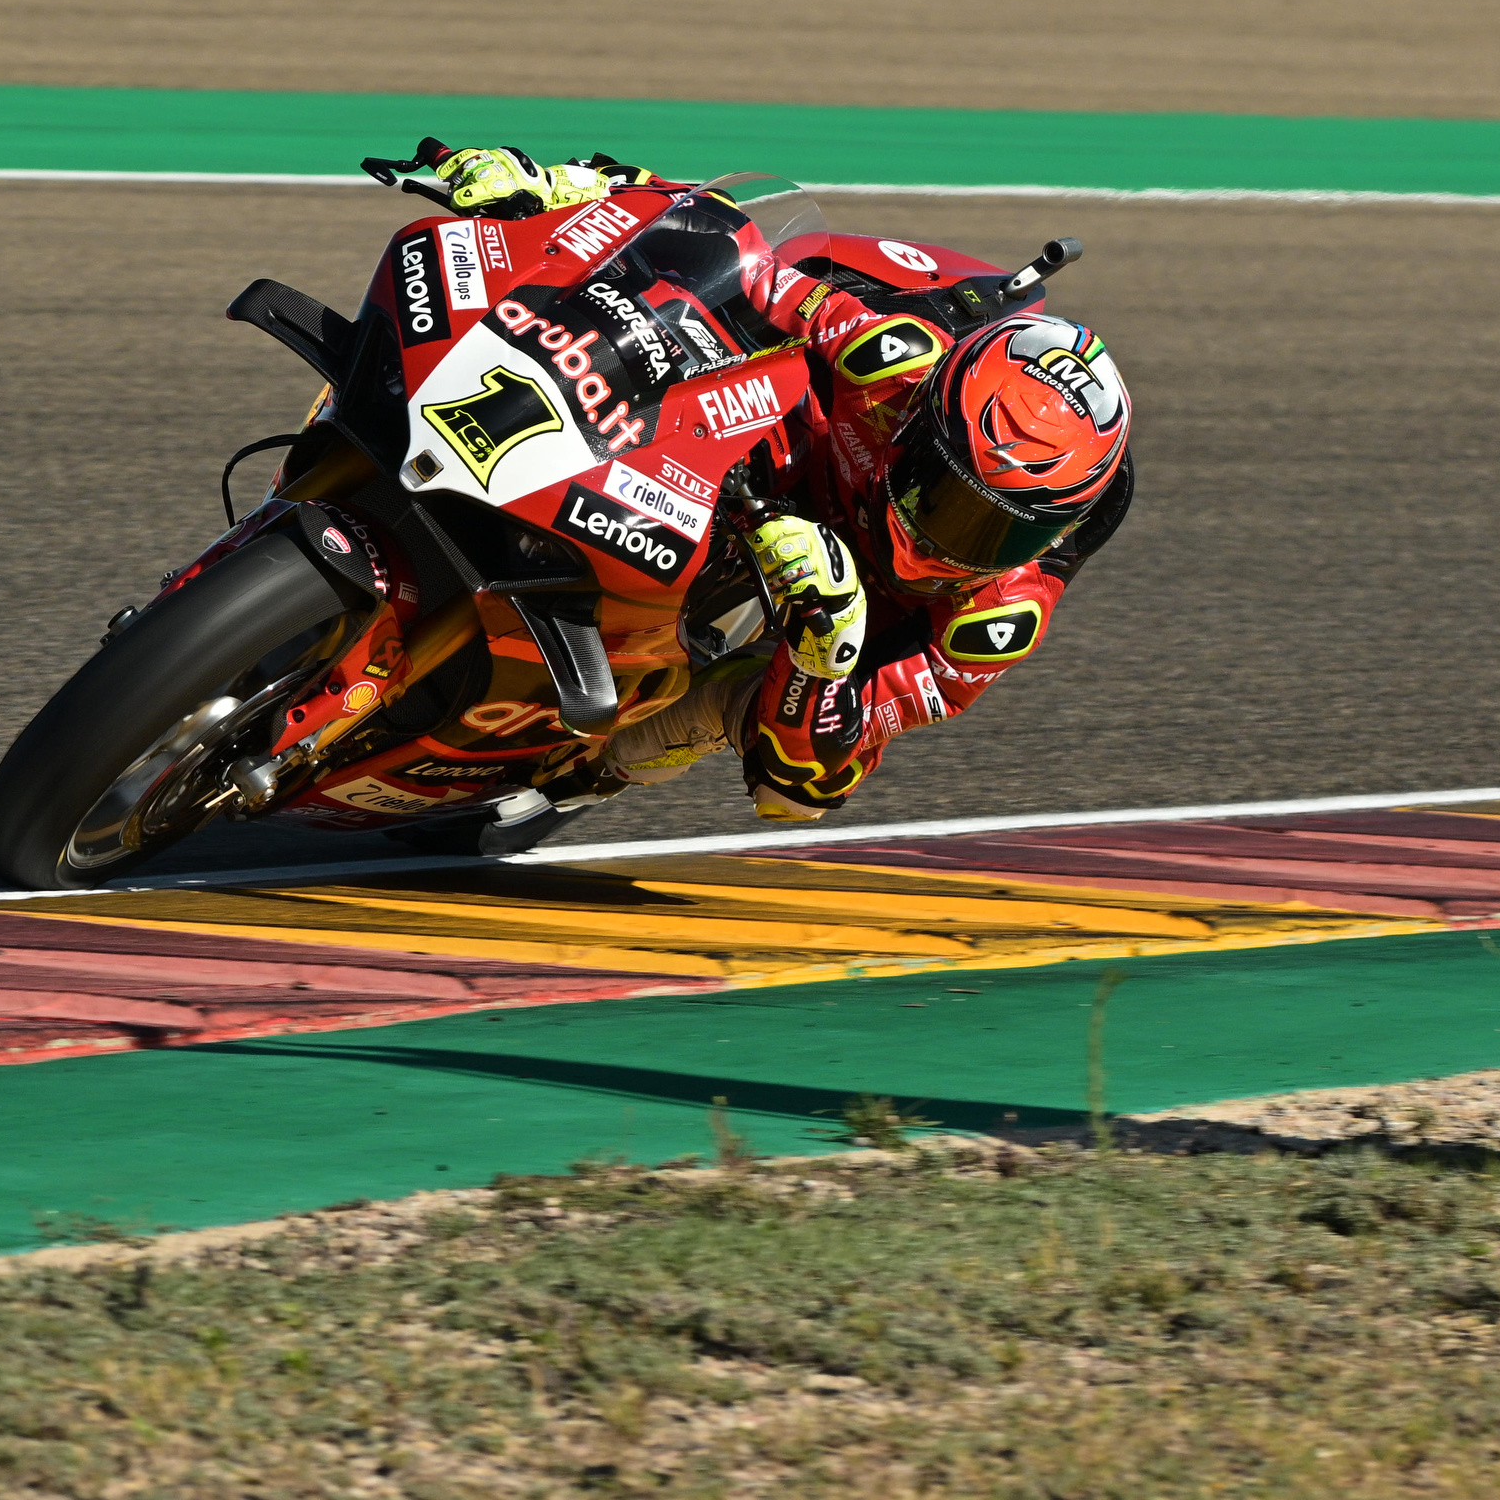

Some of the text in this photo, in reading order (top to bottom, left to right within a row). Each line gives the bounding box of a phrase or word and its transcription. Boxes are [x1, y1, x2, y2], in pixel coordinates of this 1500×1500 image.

[483, 224, 505, 269] STULZ
[557, 201, 640, 262] FIAMM
[402, 237, 434, 333] Lenovo
[451, 243, 477, 300] riello ups
[587, 282, 671, 381] CARRERA
[495, 300, 645, 451] aruba.it
[697, 374, 781, 431] FIAMM
[1023, 364, 1086, 416] Motostorm
[421, 365, 564, 494] 1
[633, 482, 698, 530] riello ups
[661, 462, 714, 501] STULZ
[933, 438, 1036, 522] DITTA EDILE BALDINI CORRADO
[567, 496, 678, 571] Lenovo
[783, 668, 810, 716] novo
[815, 675, 848, 734] ba.it
[883, 705, 899, 735] STULZ
[406, 761, 504, 778] Lenovo
